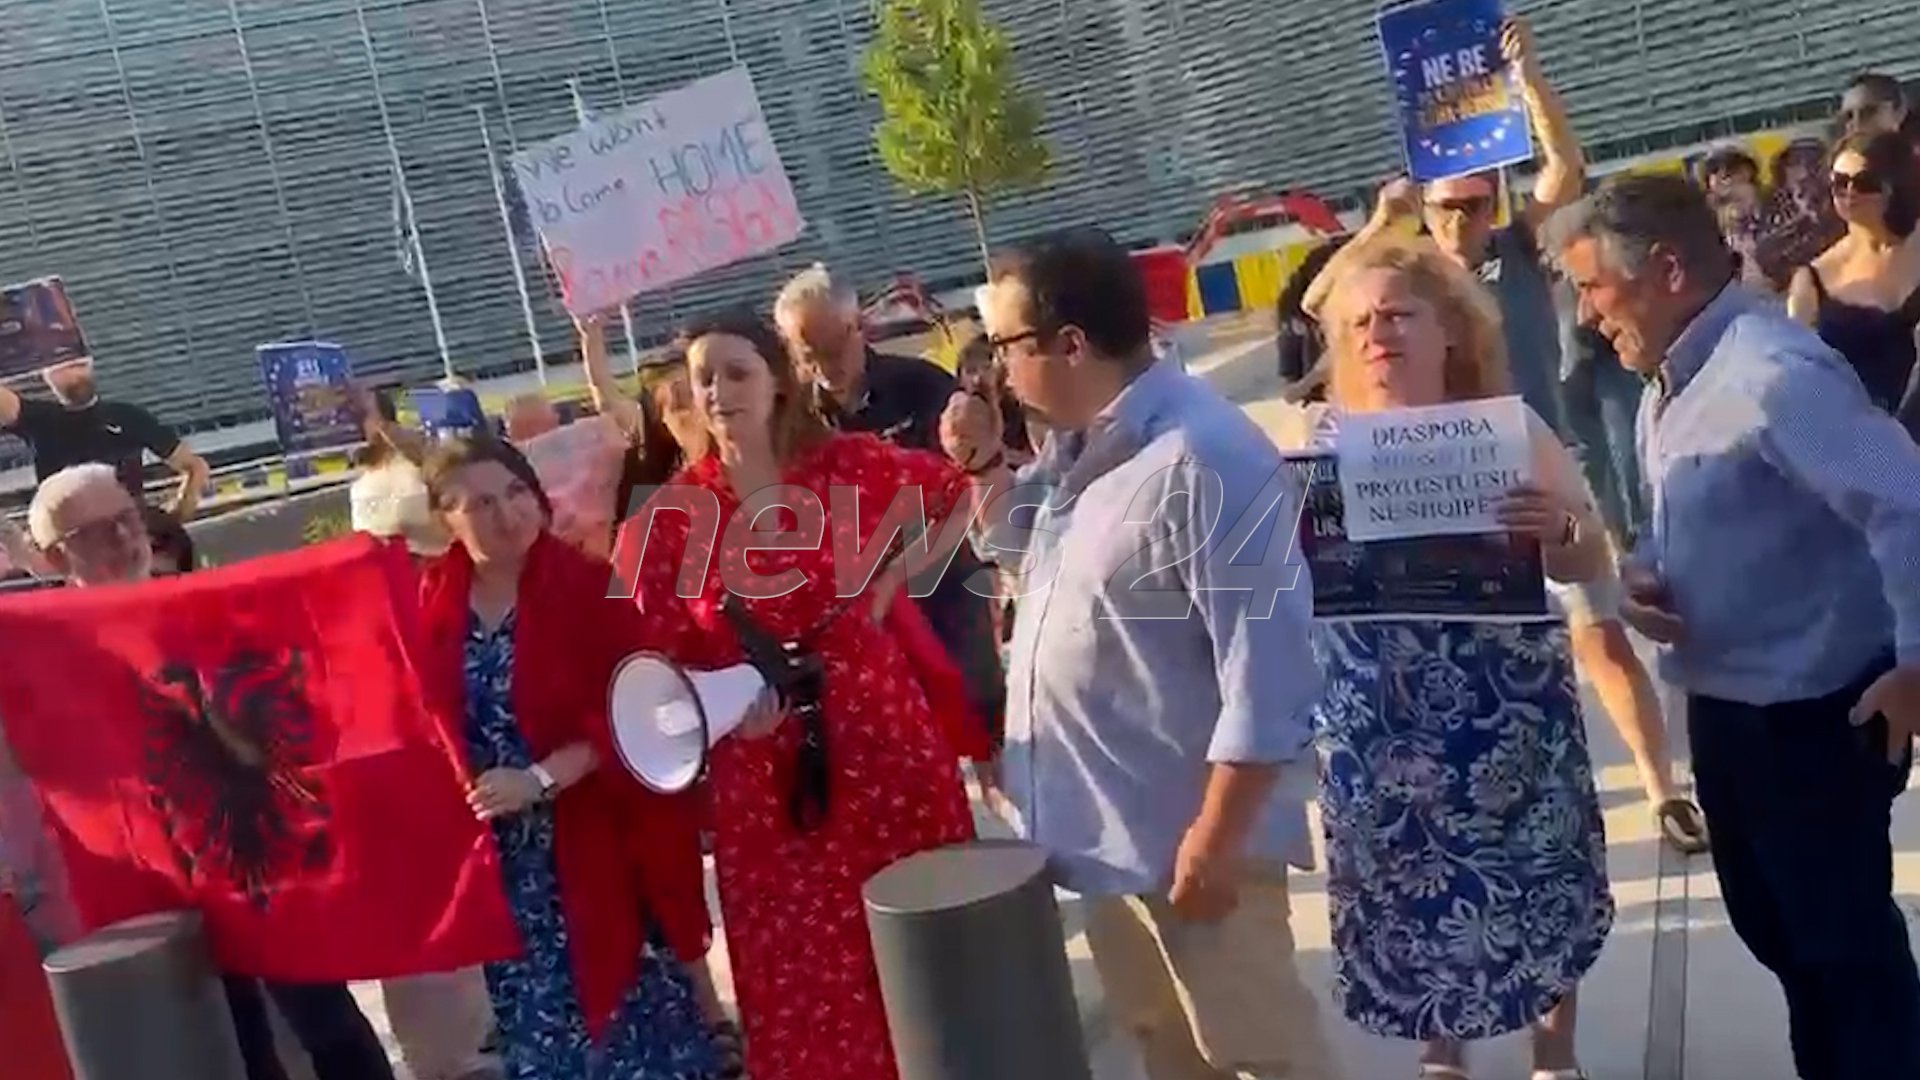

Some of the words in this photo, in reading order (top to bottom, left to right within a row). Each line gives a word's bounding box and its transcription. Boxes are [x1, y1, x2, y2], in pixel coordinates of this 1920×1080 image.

[1421, 53, 1455, 88] NE
[1457, 44, 1490, 77] BE
[650, 121, 765, 198] HOME
[1372, 418, 1493, 447] DIASPORA
[1407, 498, 1489, 519] SHQIPE
